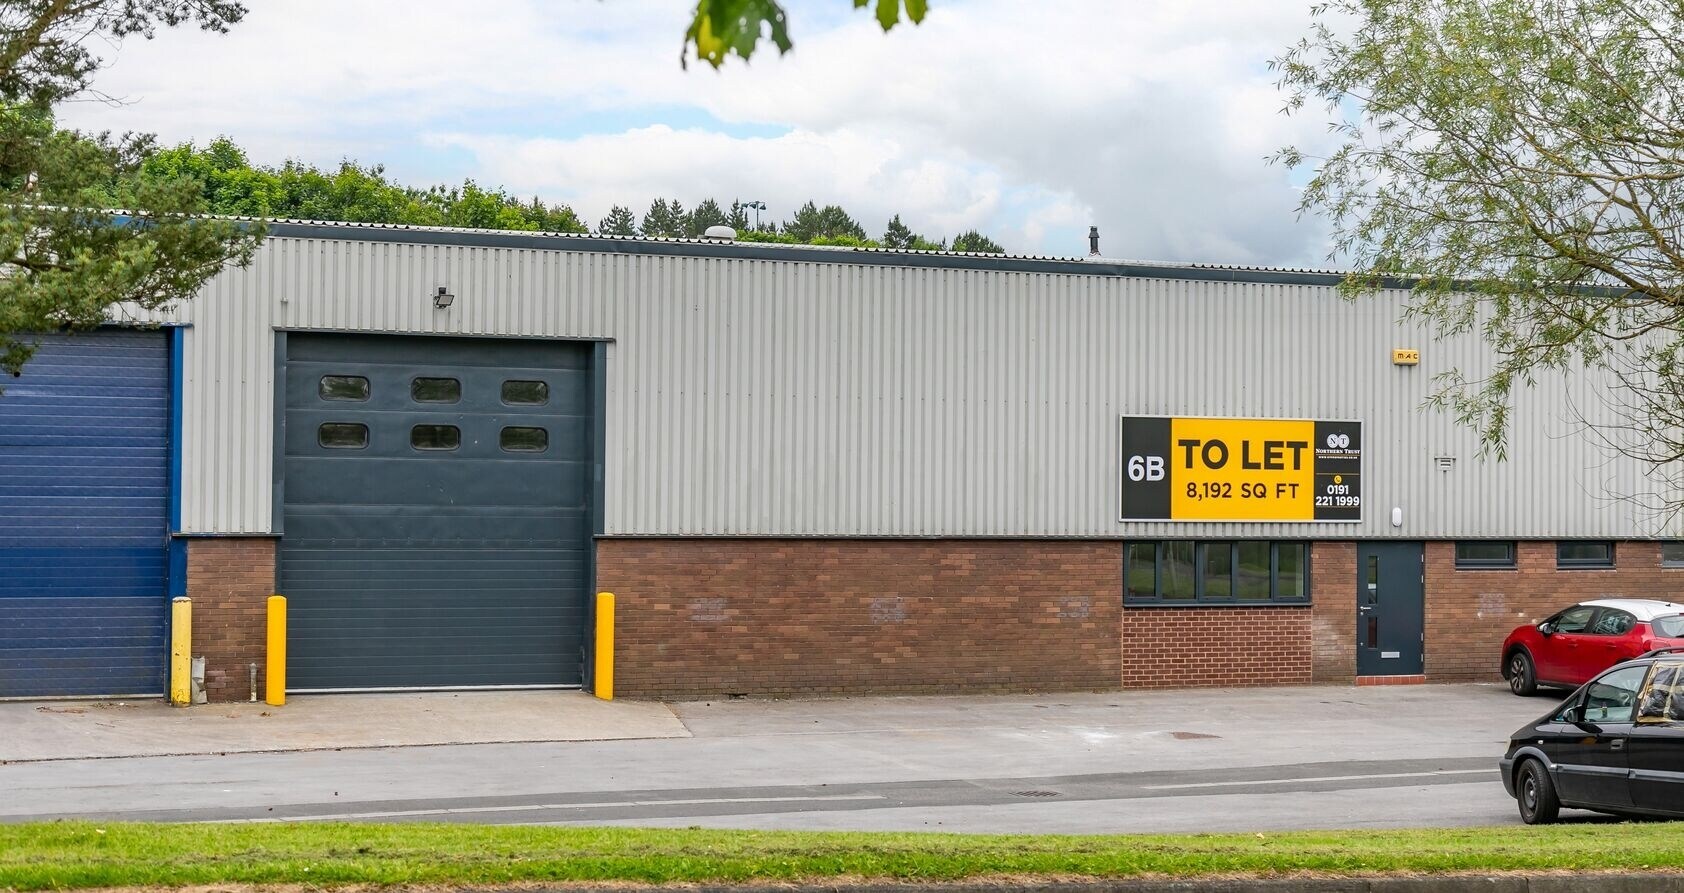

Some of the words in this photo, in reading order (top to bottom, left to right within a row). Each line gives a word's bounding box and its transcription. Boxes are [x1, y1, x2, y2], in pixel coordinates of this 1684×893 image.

[1178, 439, 1229, 470] TO
[1241, 440, 1308, 470] LET
[1128, 455, 1165, 481] 6B
[1186, 482, 1232, 501] 8,192
[1241, 482, 1267, 499] SQ
[1276, 483, 1299, 499] FT
[1327, 485, 1349, 494] 0191
[1315, 496, 1333, 506] 221
[1336, 496, 1360, 506] 1999
